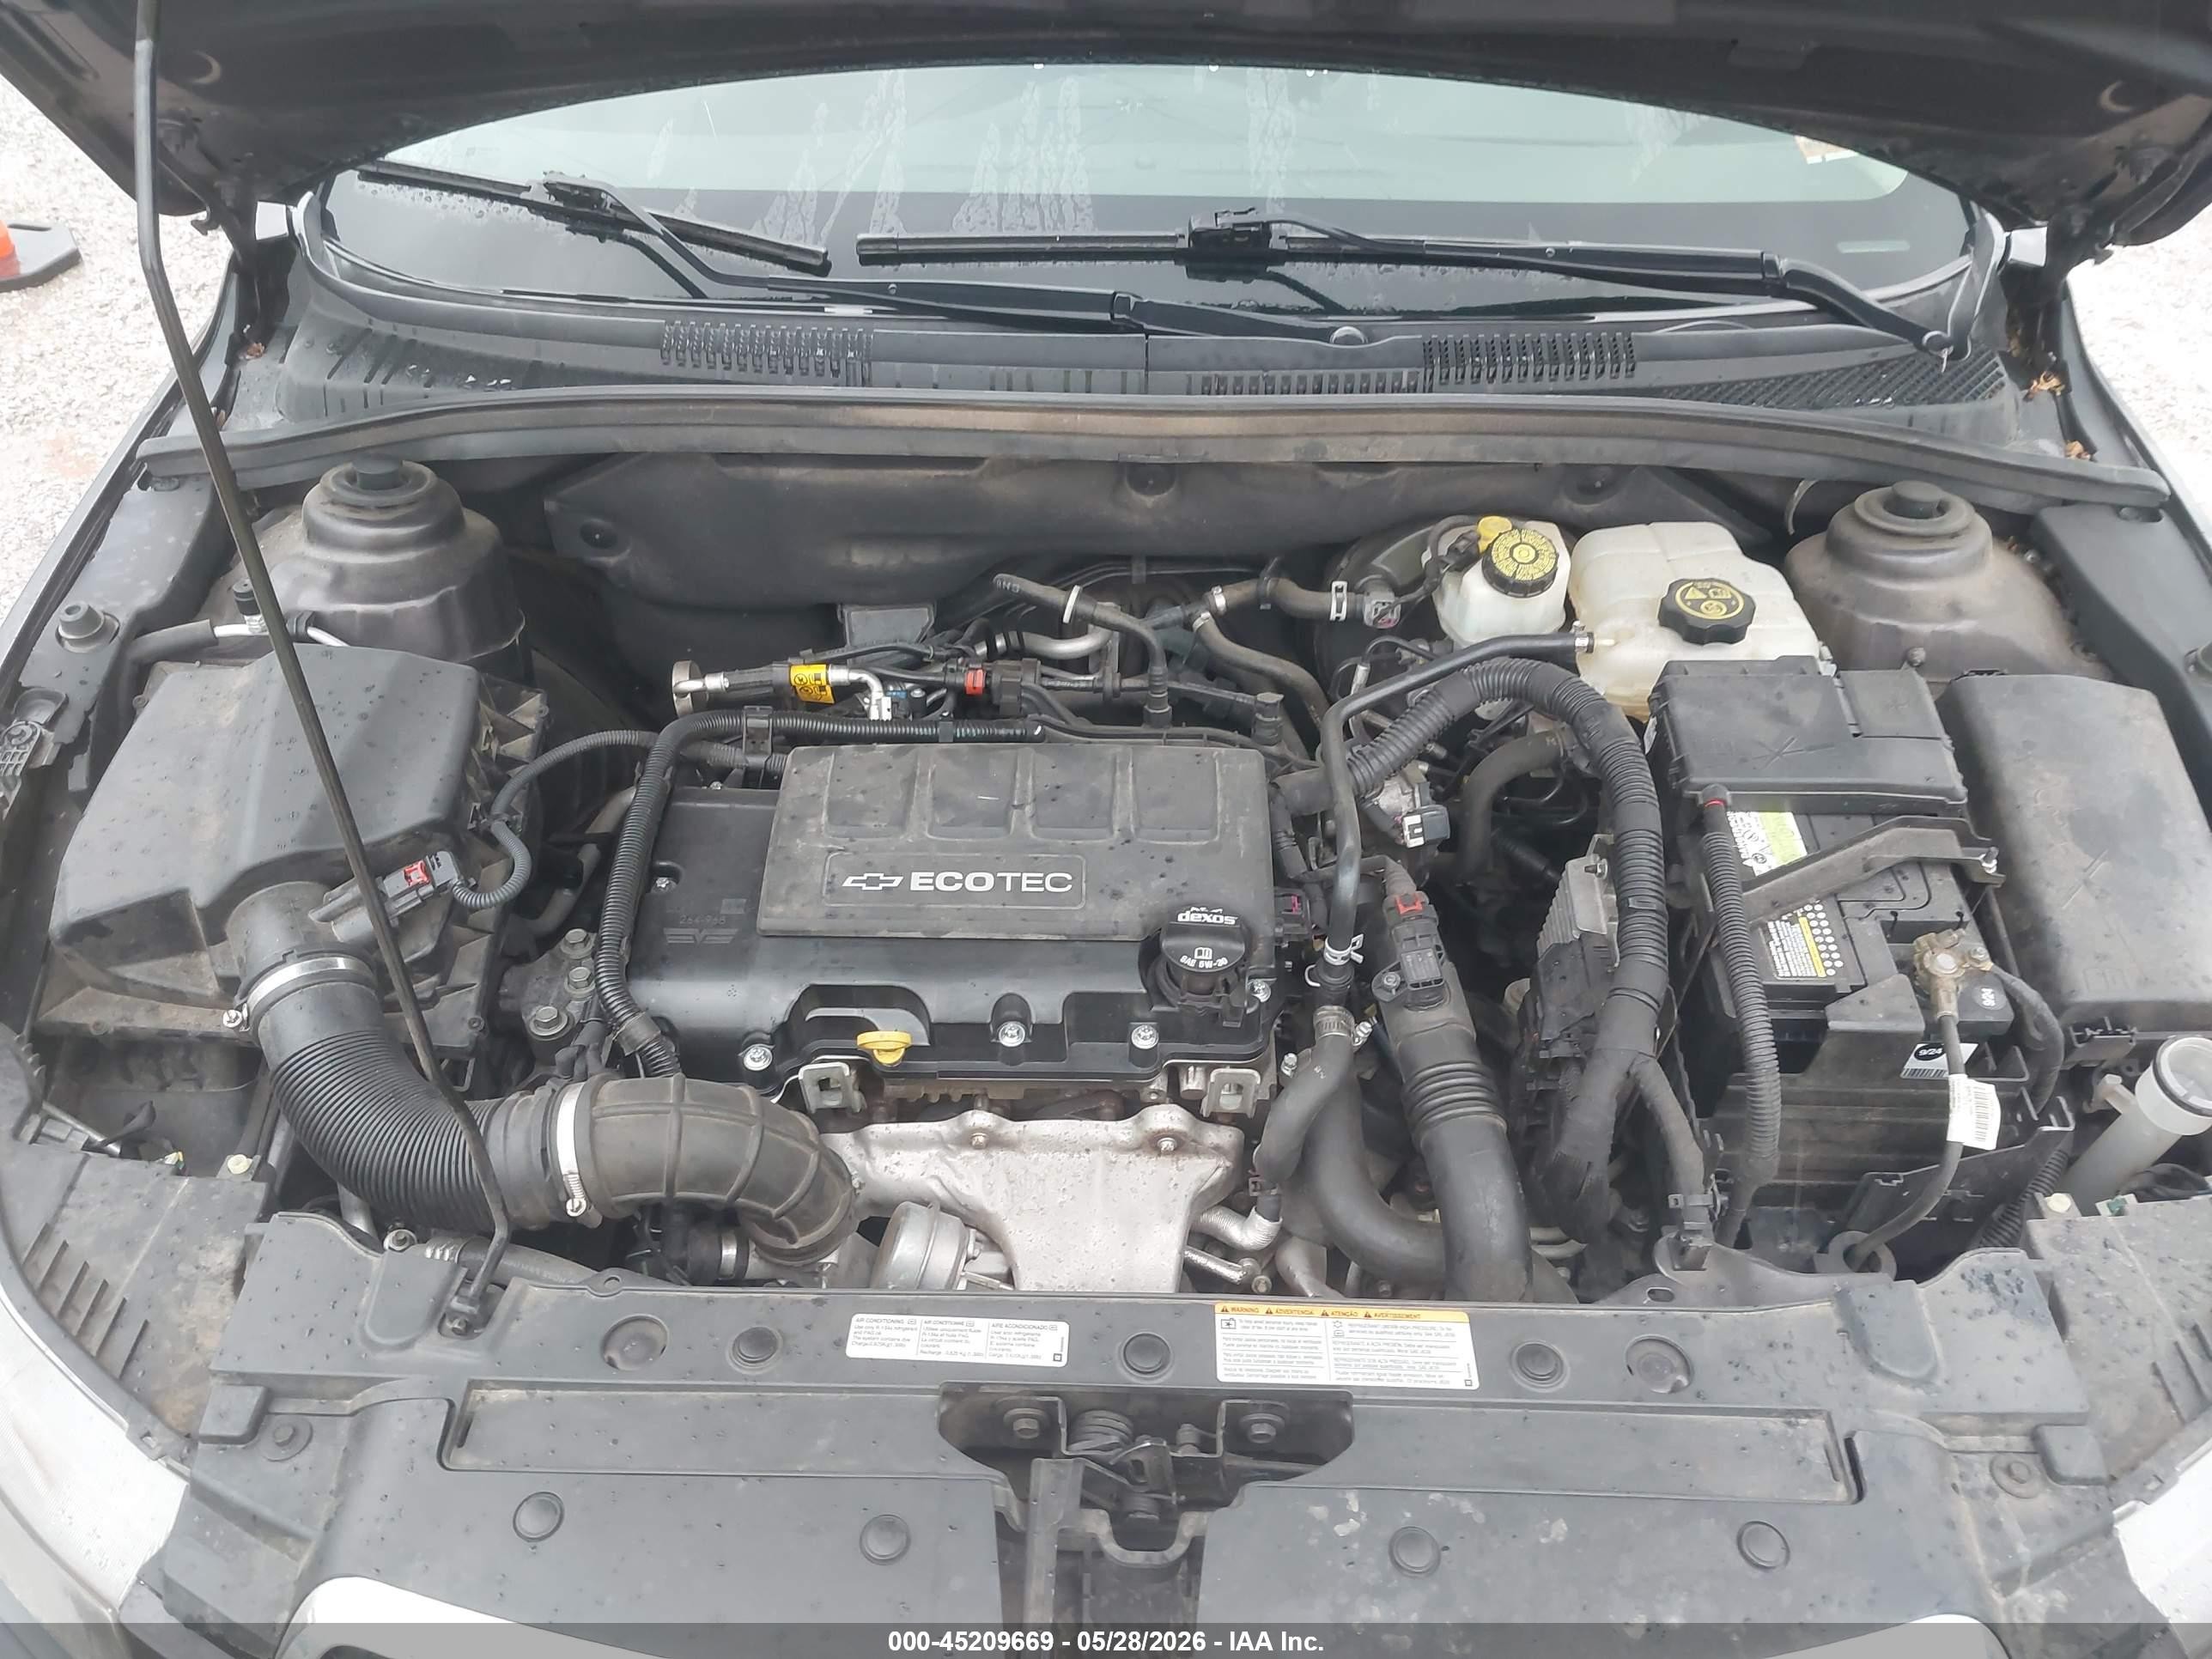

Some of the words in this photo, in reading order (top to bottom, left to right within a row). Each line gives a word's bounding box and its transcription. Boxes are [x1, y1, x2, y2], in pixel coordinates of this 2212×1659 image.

[910, 871, 1073, 892] ECOTEC
[1177, 910, 1238, 925] dexos
[1180, 955, 1197, 967] SAE
[1918, 1048, 1943, 1056] 9/24
